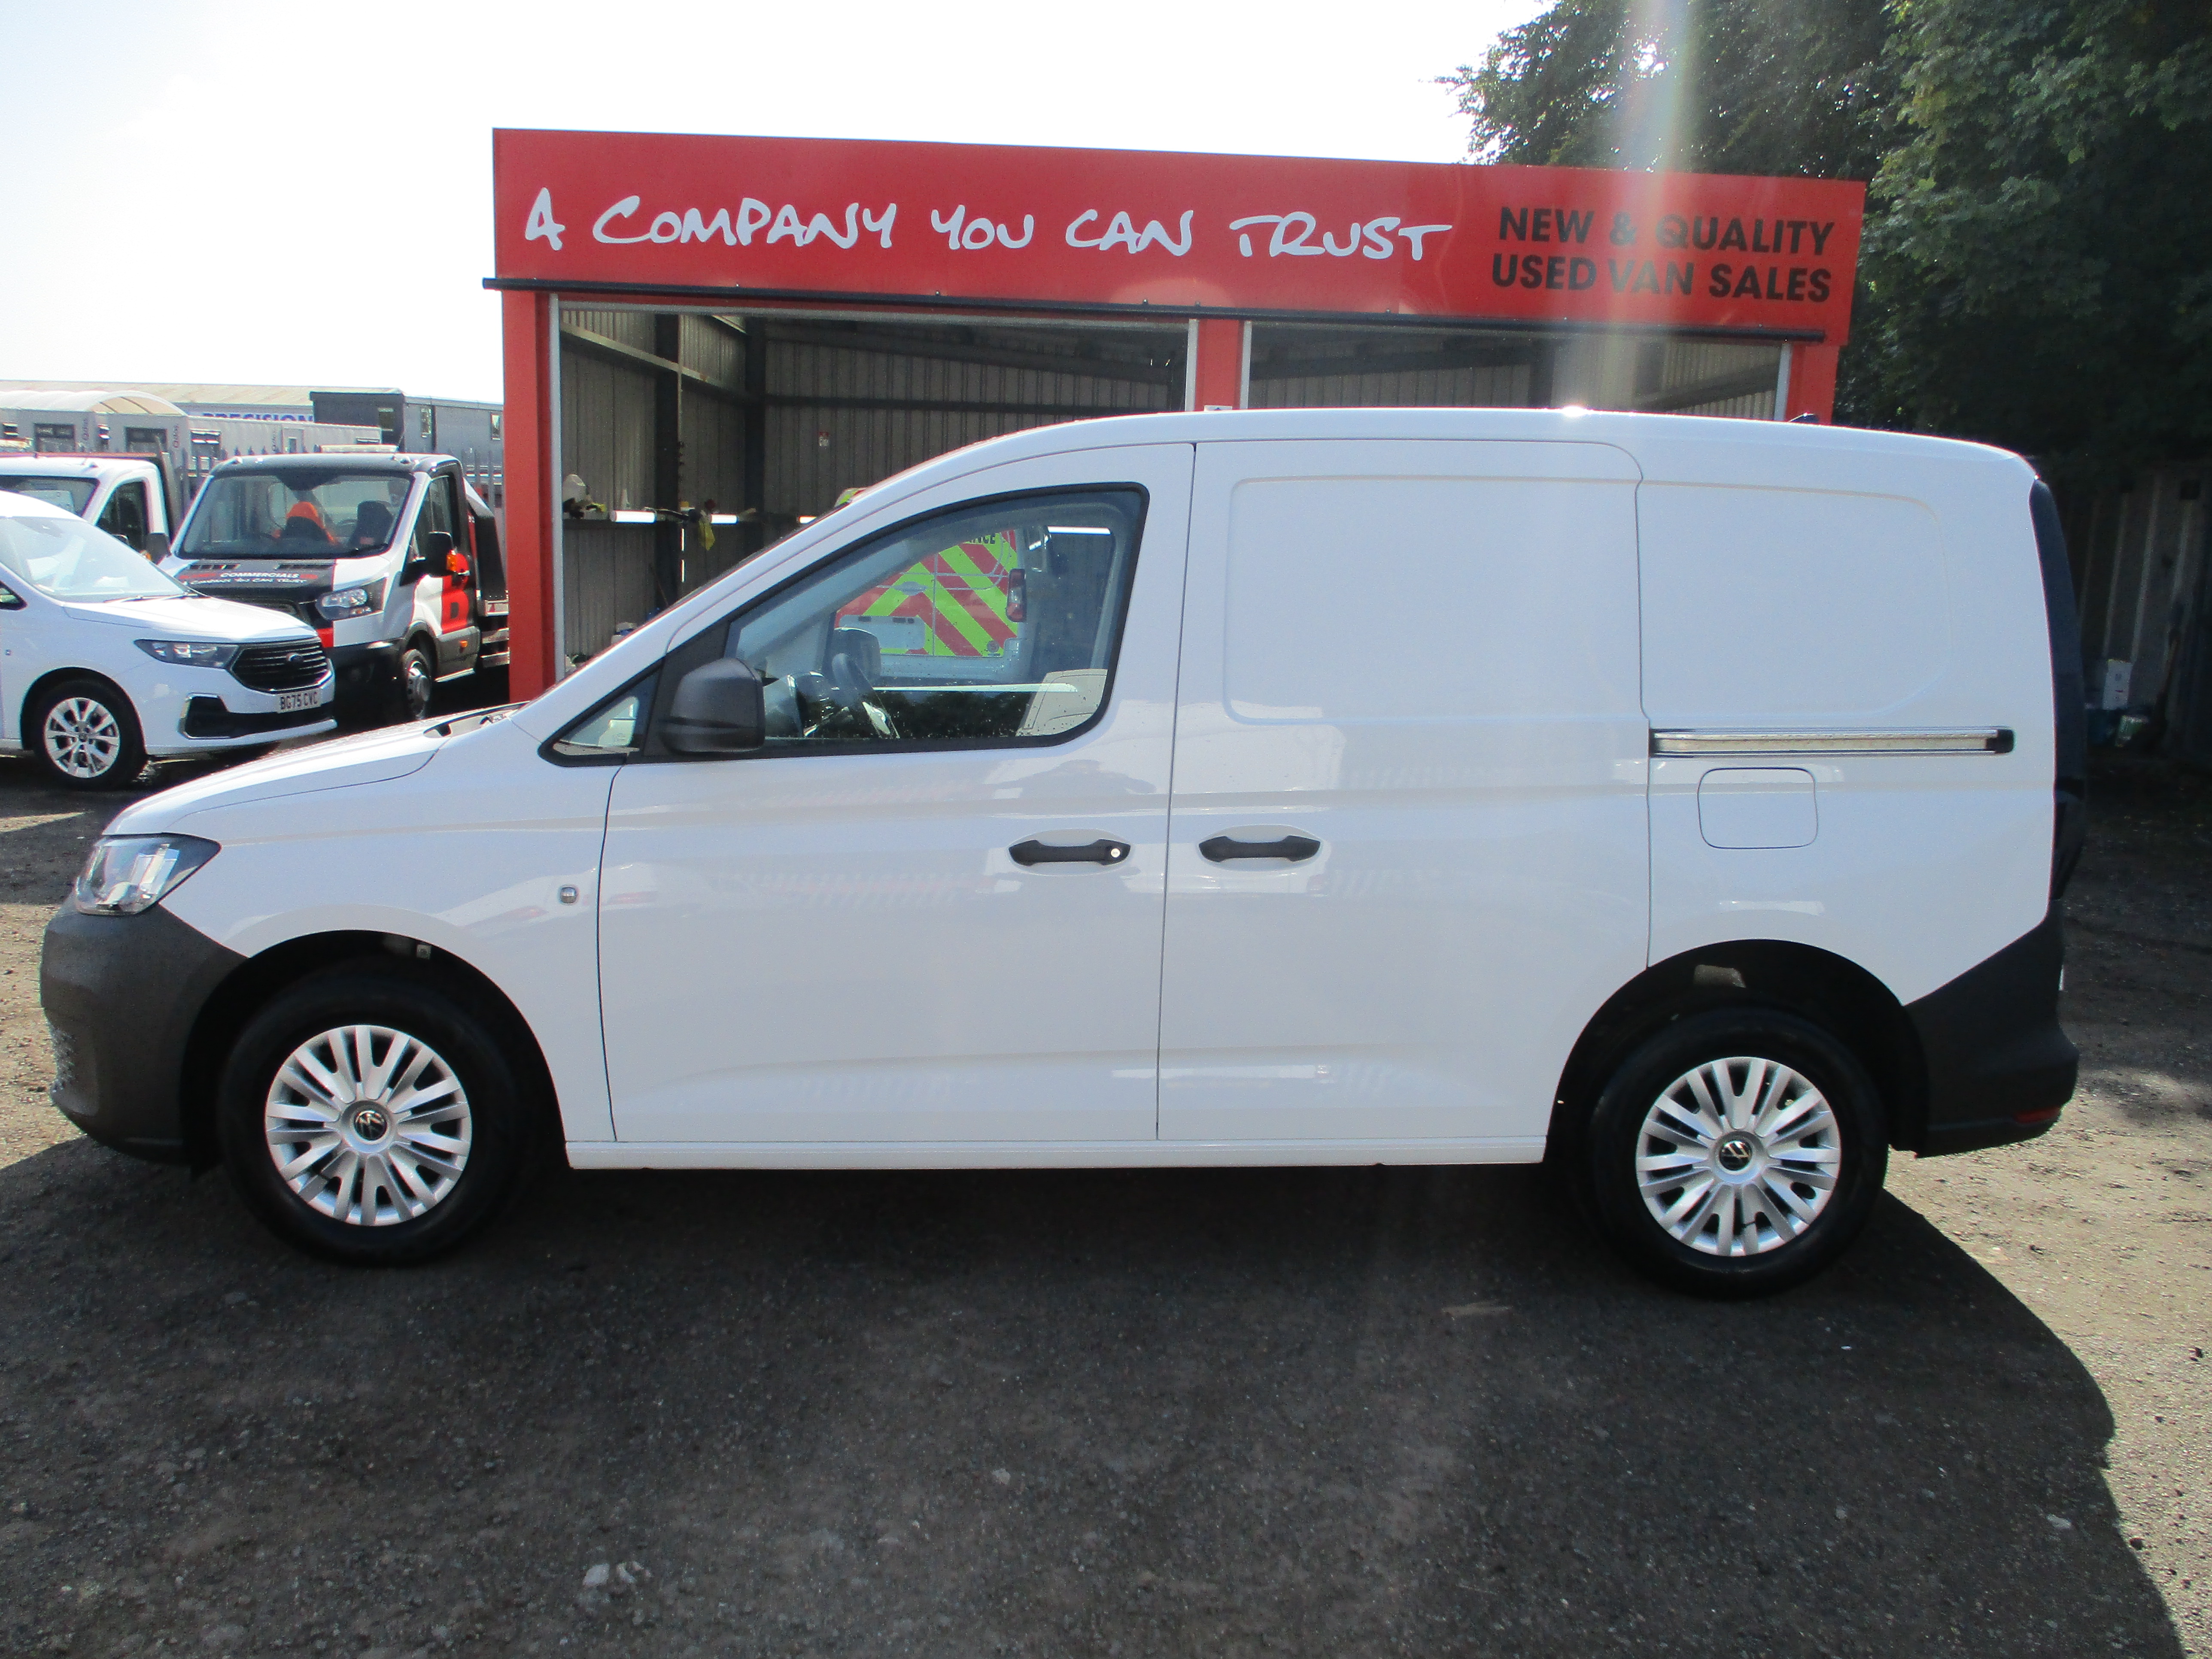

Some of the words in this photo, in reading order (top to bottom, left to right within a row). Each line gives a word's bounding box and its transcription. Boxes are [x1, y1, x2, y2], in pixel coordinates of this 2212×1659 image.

[525, 187, 566, 251] A
[592, 195, 897, 249] COMPANY
[930, 204, 1034, 250] YOU
[1065, 209, 1194, 257] CAN
[1229, 211, 1453, 261] TRUST
[1499, 206, 1595, 245] NEW
[1609, 211, 1637, 246] &
[1655, 214, 1835, 256] QUALITY
[1492, 252, 1597, 292] USED
[1607, 259, 1695, 296] VAN
[1708, 263, 1832, 303] SALES
